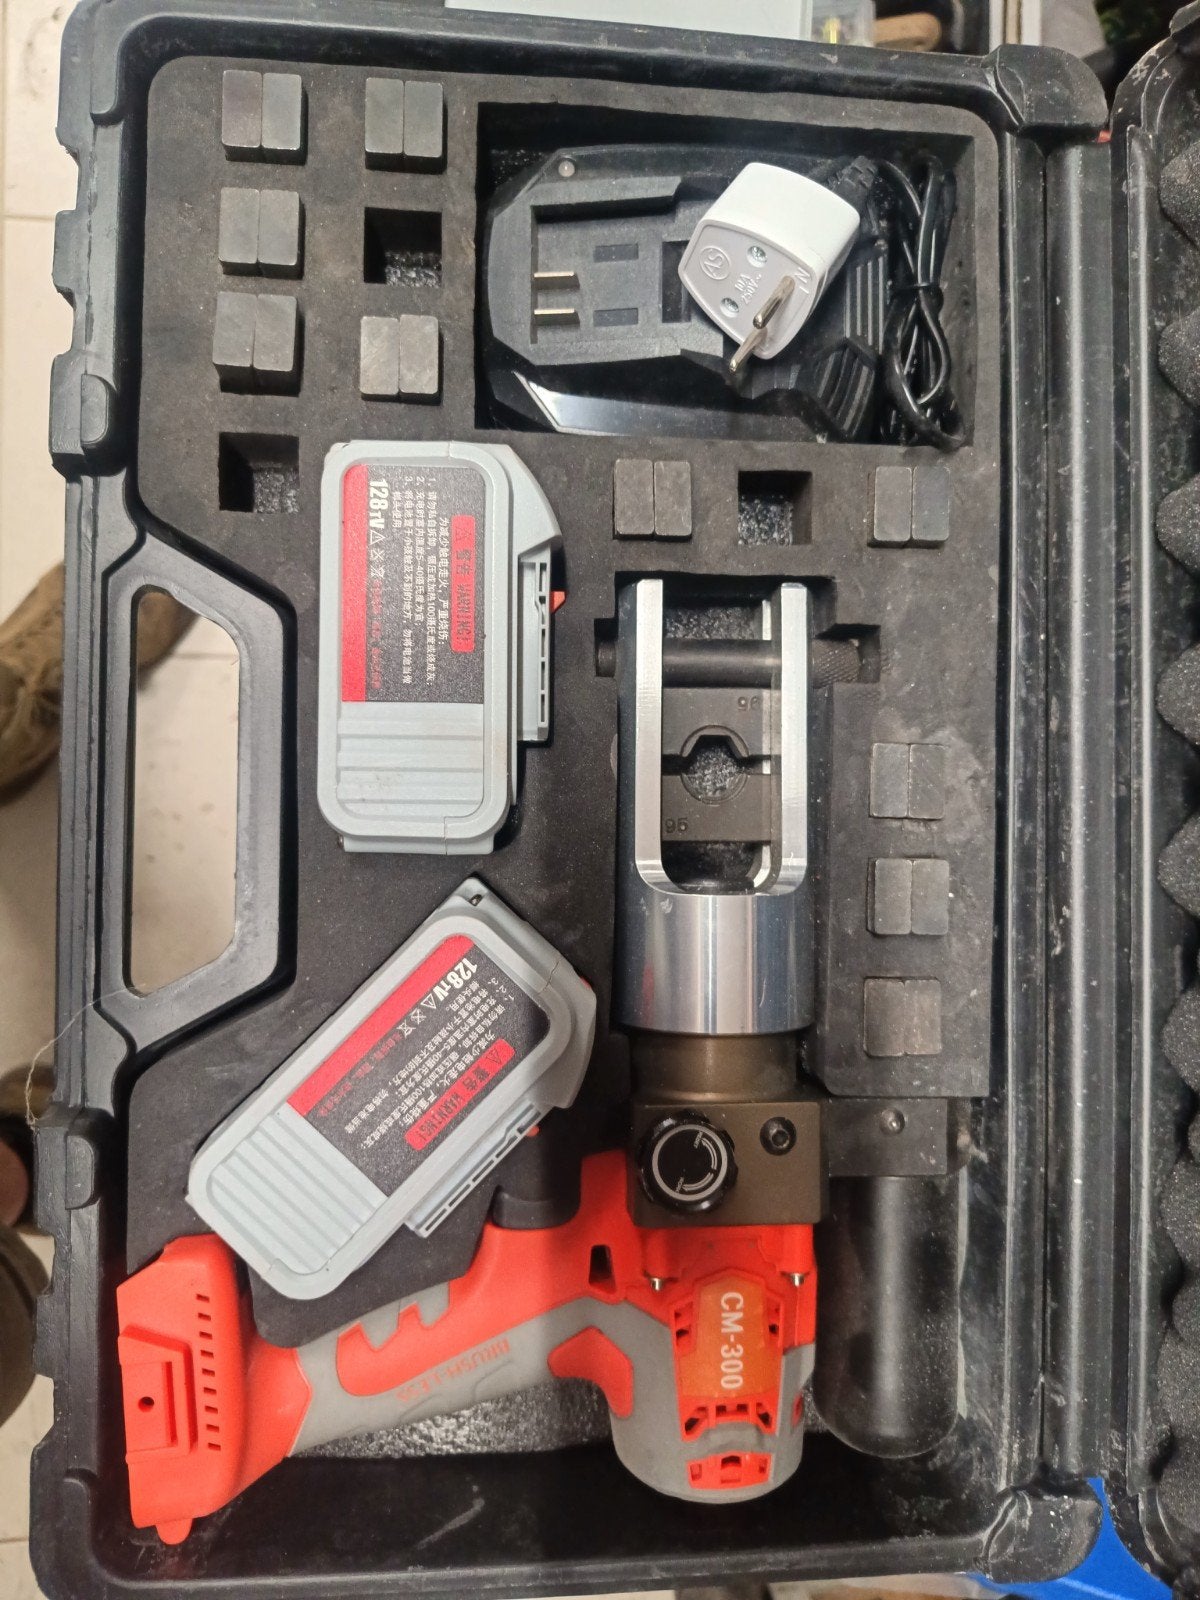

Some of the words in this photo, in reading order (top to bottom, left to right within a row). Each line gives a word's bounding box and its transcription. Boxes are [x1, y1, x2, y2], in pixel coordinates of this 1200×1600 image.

[664, 817, 689, 834] 95
[461, 1066, 490, 1092] 警告
[718, 1291, 743, 1390] CM-300
